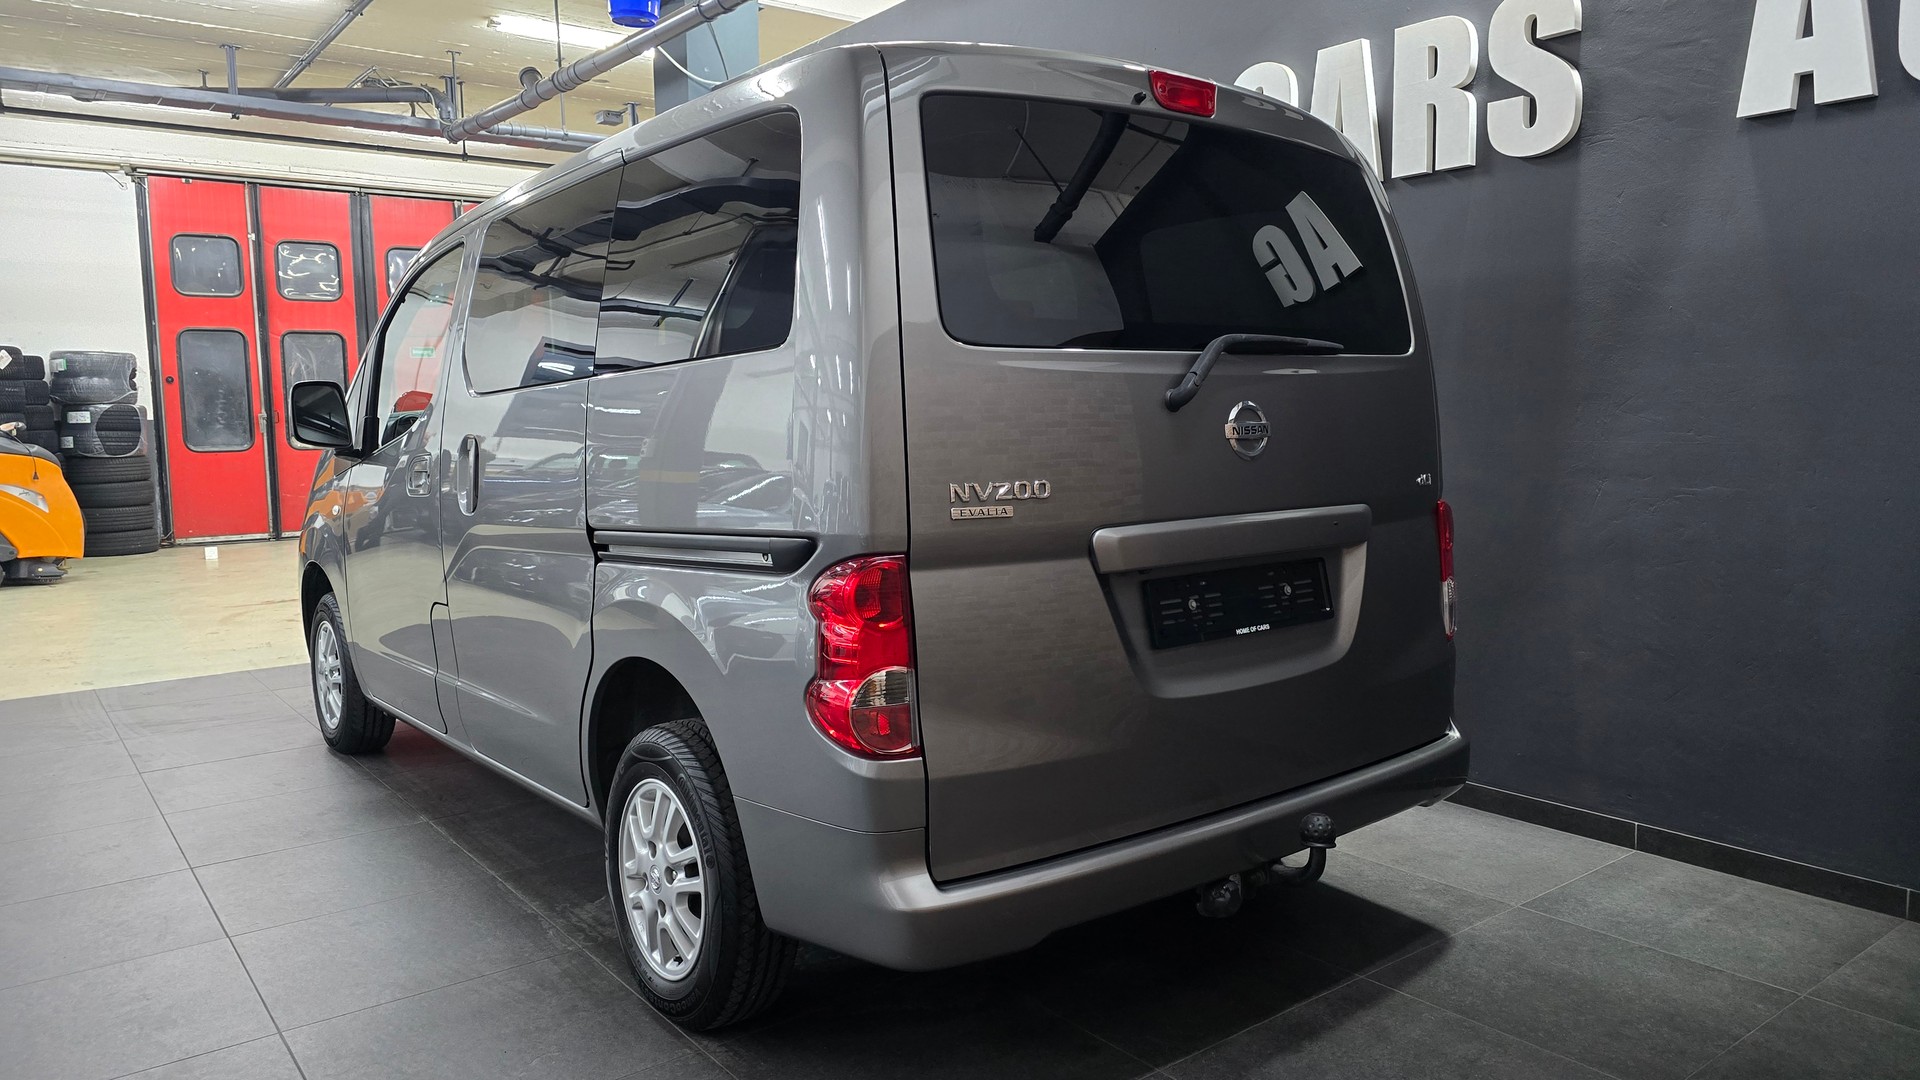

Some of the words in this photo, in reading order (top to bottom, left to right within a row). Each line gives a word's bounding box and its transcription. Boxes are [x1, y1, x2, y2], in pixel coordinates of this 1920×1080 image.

[1234, 0, 1583, 182] ARS
[1736, 0, 1920, 119] A
[1232, 425, 1269, 435] NISSAN
[949, 480, 1051, 503] NV200
[960, 507, 1008, 517] EVALIA
[1235, 627, 1250, 635] HOME
[1257, 623, 1270, 631] CARS
